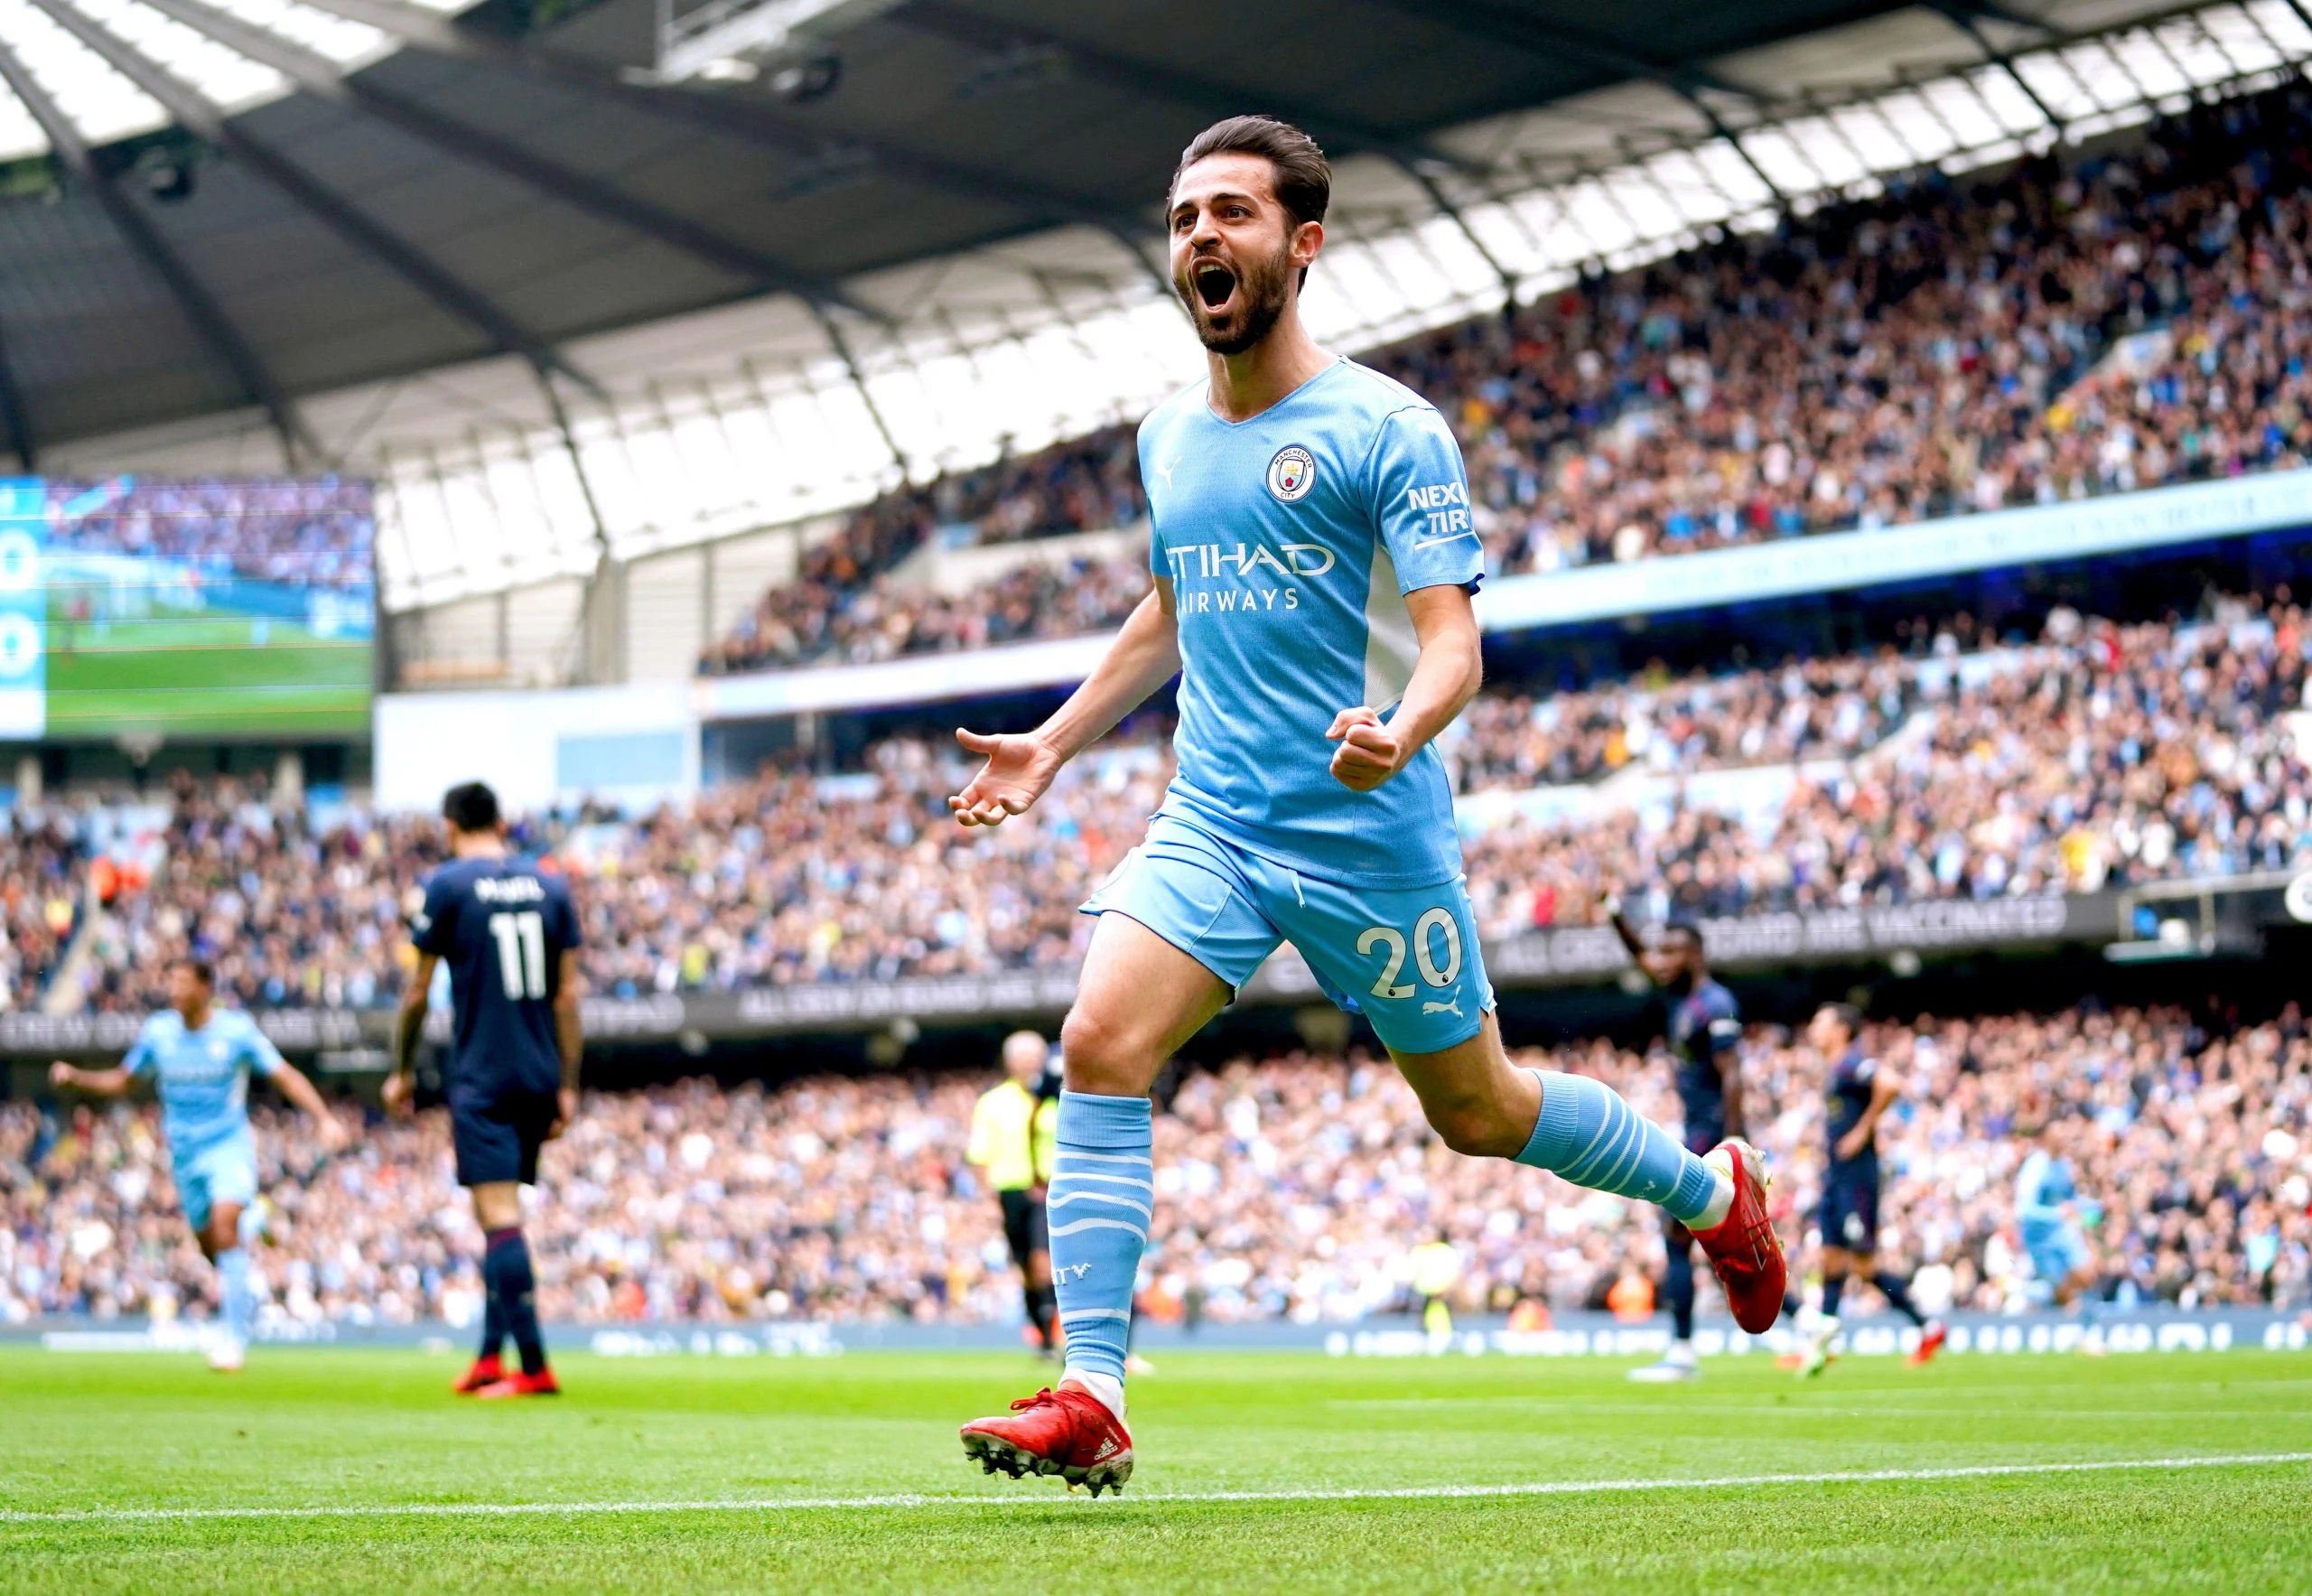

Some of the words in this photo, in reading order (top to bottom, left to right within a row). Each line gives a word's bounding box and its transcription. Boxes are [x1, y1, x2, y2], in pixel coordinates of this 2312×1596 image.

[1275, 450, 1312, 469] MANCHESTER
[489, 911, 546, 1001] 11
[1356, 906, 1462, 999] 20
